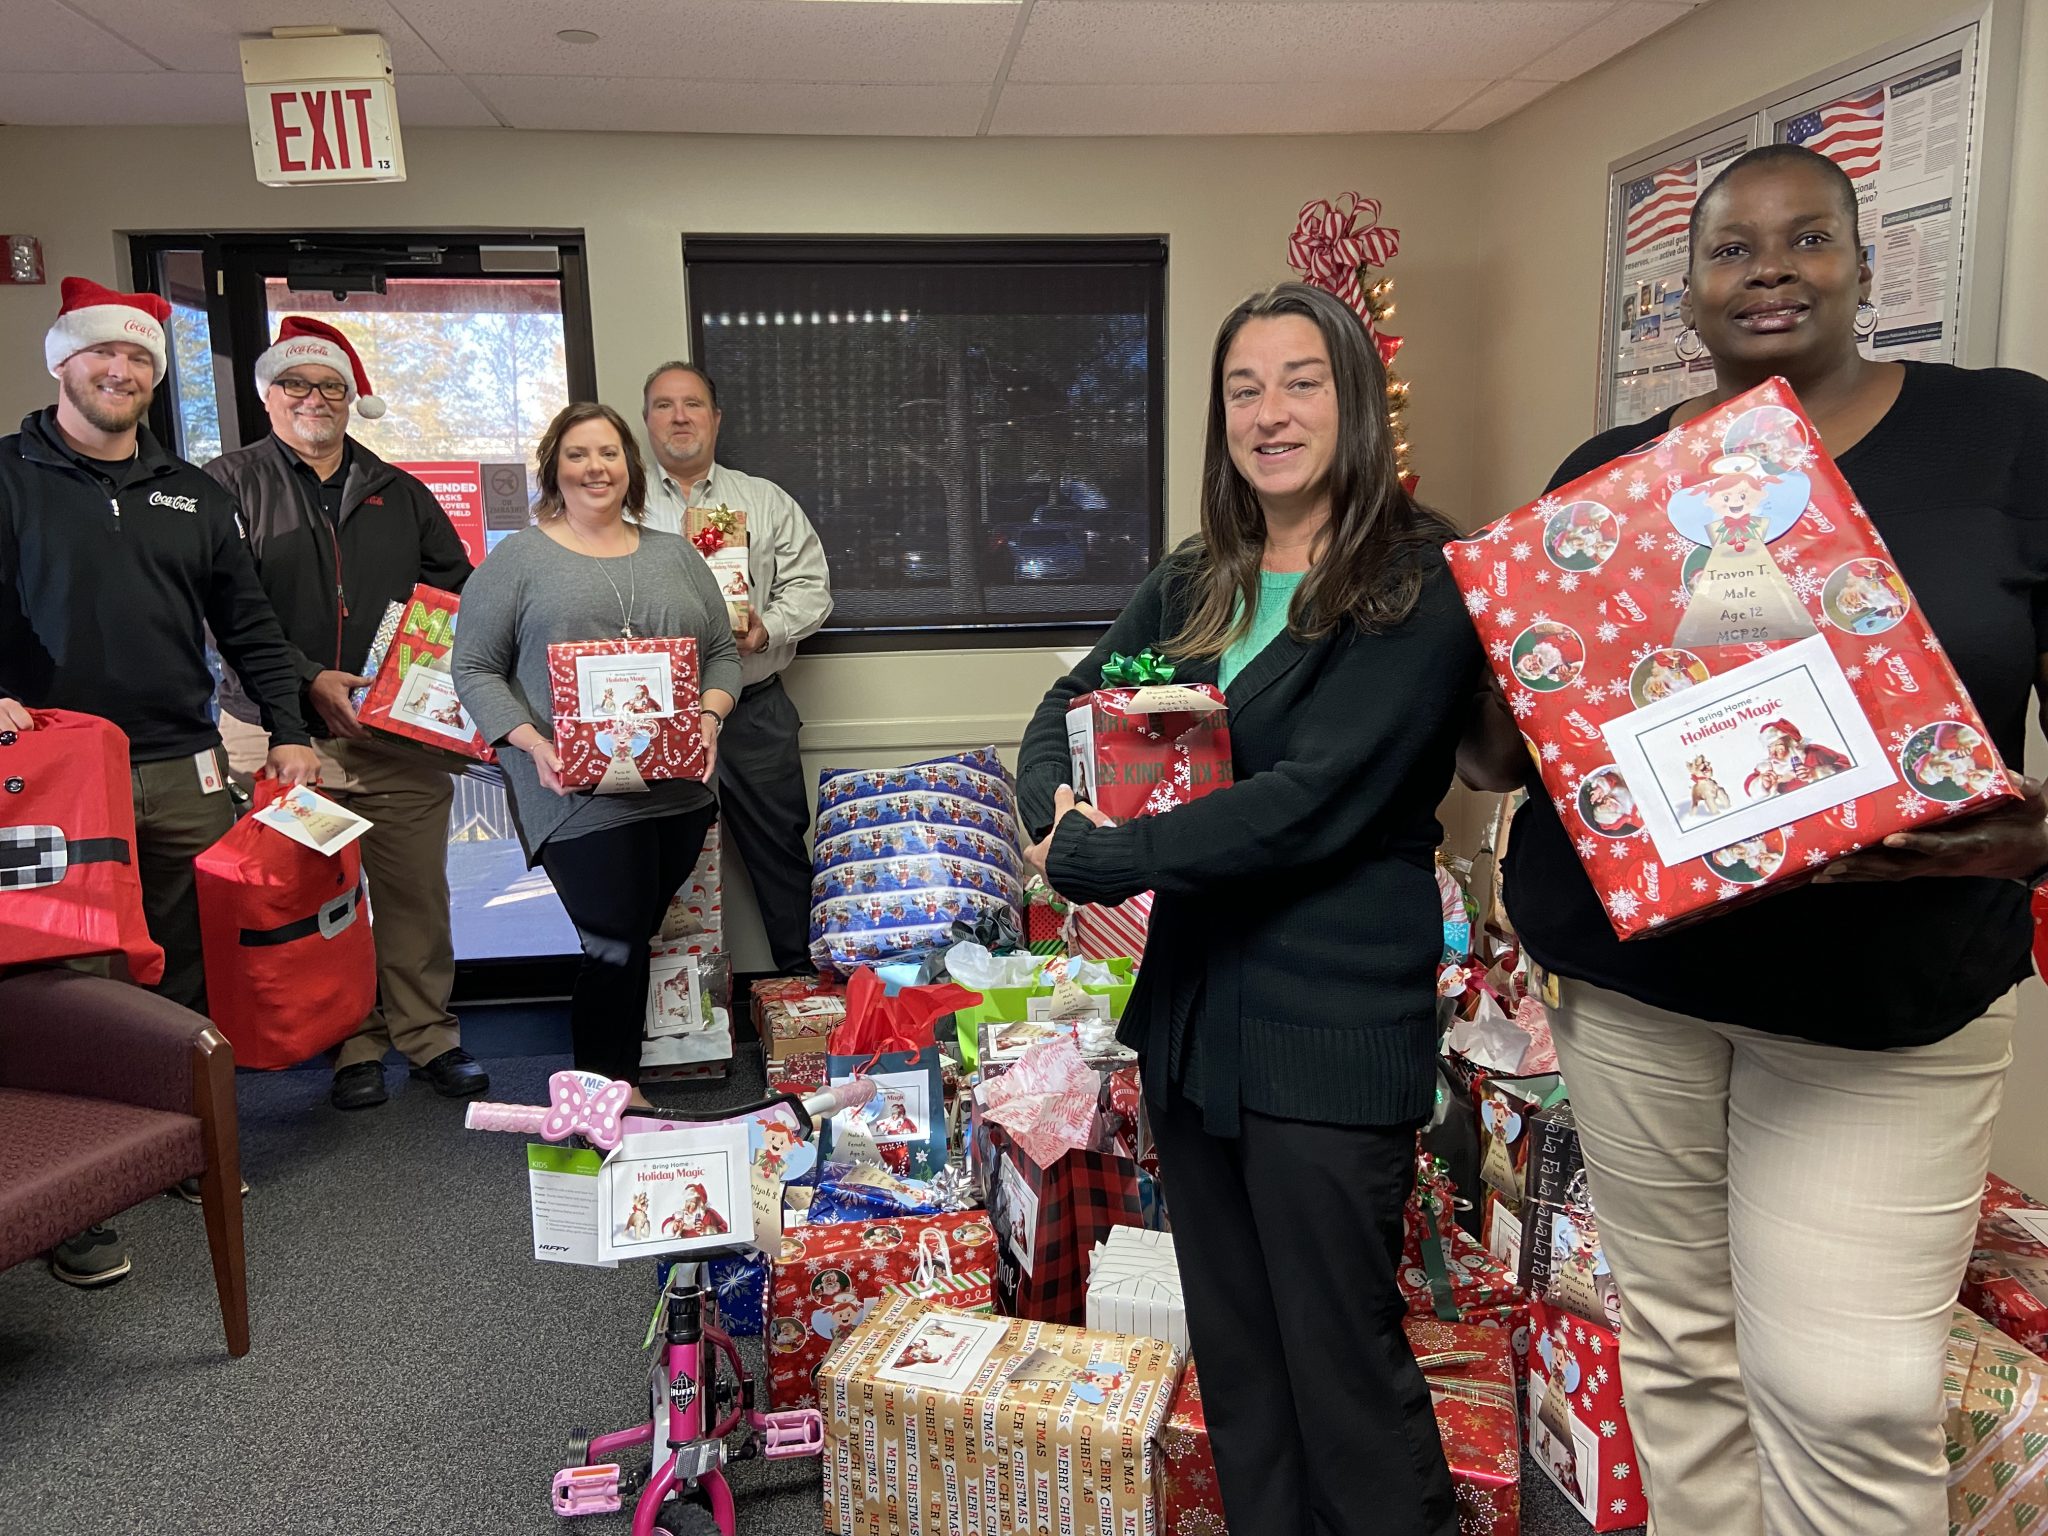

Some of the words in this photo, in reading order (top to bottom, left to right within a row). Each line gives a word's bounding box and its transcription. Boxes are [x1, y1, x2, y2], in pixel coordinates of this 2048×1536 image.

[270, 89, 373, 171] EXIT
[378, 160, 391, 169] 13
[149, 490, 198, 513] Coca-Cola
[1707, 569, 1754, 581] Travon
[1756, 564, 1770, 575] T.
[1722, 586, 1757, 601] Male
[1716, 628, 1749, 643] MCP
[1752, 626, 1769, 639] 26
[1720, 609, 1747, 622] Age
[1749, 606, 1763, 617] 12
[1680, 717, 1738, 747] Holiday
[1736, 698, 1783, 723] Magic
[1697, 709, 1724, 725] Bring
[1724, 698, 1752, 713] Home
[1124, 761, 1166, 785] KIND
[1643, 860, 1660, 902] Coca-Cola
[584, 1077, 605, 1090] ME
[886, 1094, 904, 1102] Magic
[532, 1161, 548, 1169] KIDS
[637, 1170, 674, 1182] Holiday
[676, 1166, 705, 1178] Magic
[539, 1244, 571, 1252] HUFFY
[670, 1387, 696, 1397] HUFFY
[1132, 1383, 1151, 1417] MERRY
[925, 1395, 940, 1471] CHRISTMAS
[963, 1390, 978, 1464] CHRISTMAS
[984, 1381, 1006, 1448] CHRISTMAS
[1036, 1387, 1056, 1457] CHRISTMAS
[838, 1438, 849, 1482] MERRY
[864, 1419, 878, 1494] CHRISTMAS
[905, 1416, 917, 1460] MERRY
[944, 1416, 955, 1461] MERRY
[1122, 1418, 1137, 1495] CHRISTMAS
[823, 1454, 832, 1498] MERRY
[886, 1446, 897, 1492] MERRY
[1058, 1447, 1069, 1494] MERRY
[1080, 1425, 1094, 1505] CHRISTMAS
[1100, 1447, 1112, 1494] MERRY
[839, 1484, 851, 1536] CHRISTM
[906, 1463, 919, 1536] CHRISTMAS
[944, 1464, 960, 1536] CHRISTMAS
[968, 1484, 978, 1528] MERRY
[985, 1467, 996, 1513] MERRY
[1014, 1451, 1028, 1525] CHRISTMAS
[1037, 1478, 1049, 1523] MERRY
[1060, 1496, 1071, 1536] CHRIS
[1100, 1496, 1113, 1536] CHRIS
